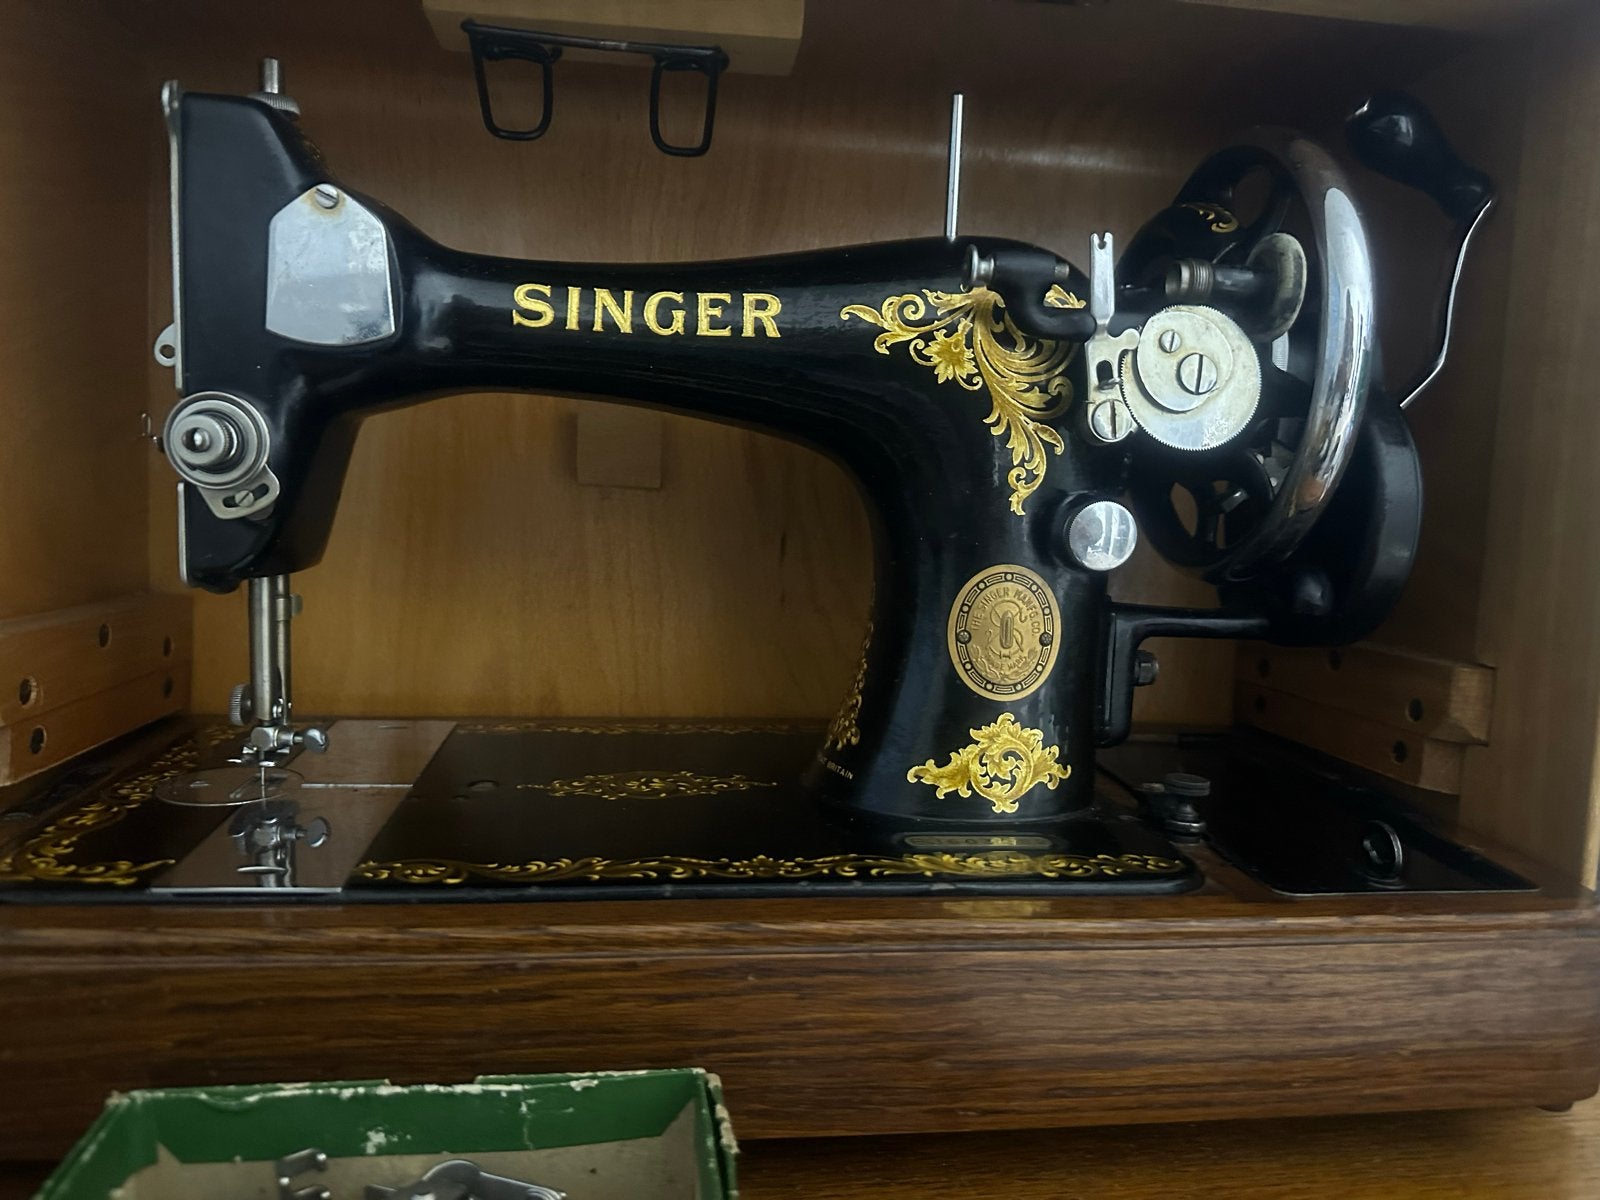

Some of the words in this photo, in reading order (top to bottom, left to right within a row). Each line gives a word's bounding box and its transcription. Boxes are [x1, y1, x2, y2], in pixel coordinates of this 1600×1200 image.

[512, 283, 782, 338] SINGER
[971, 612, 984, 631] THE
[979, 587, 1010, 611] SINGER
[826, 760, 853, 779] BRITAIN
